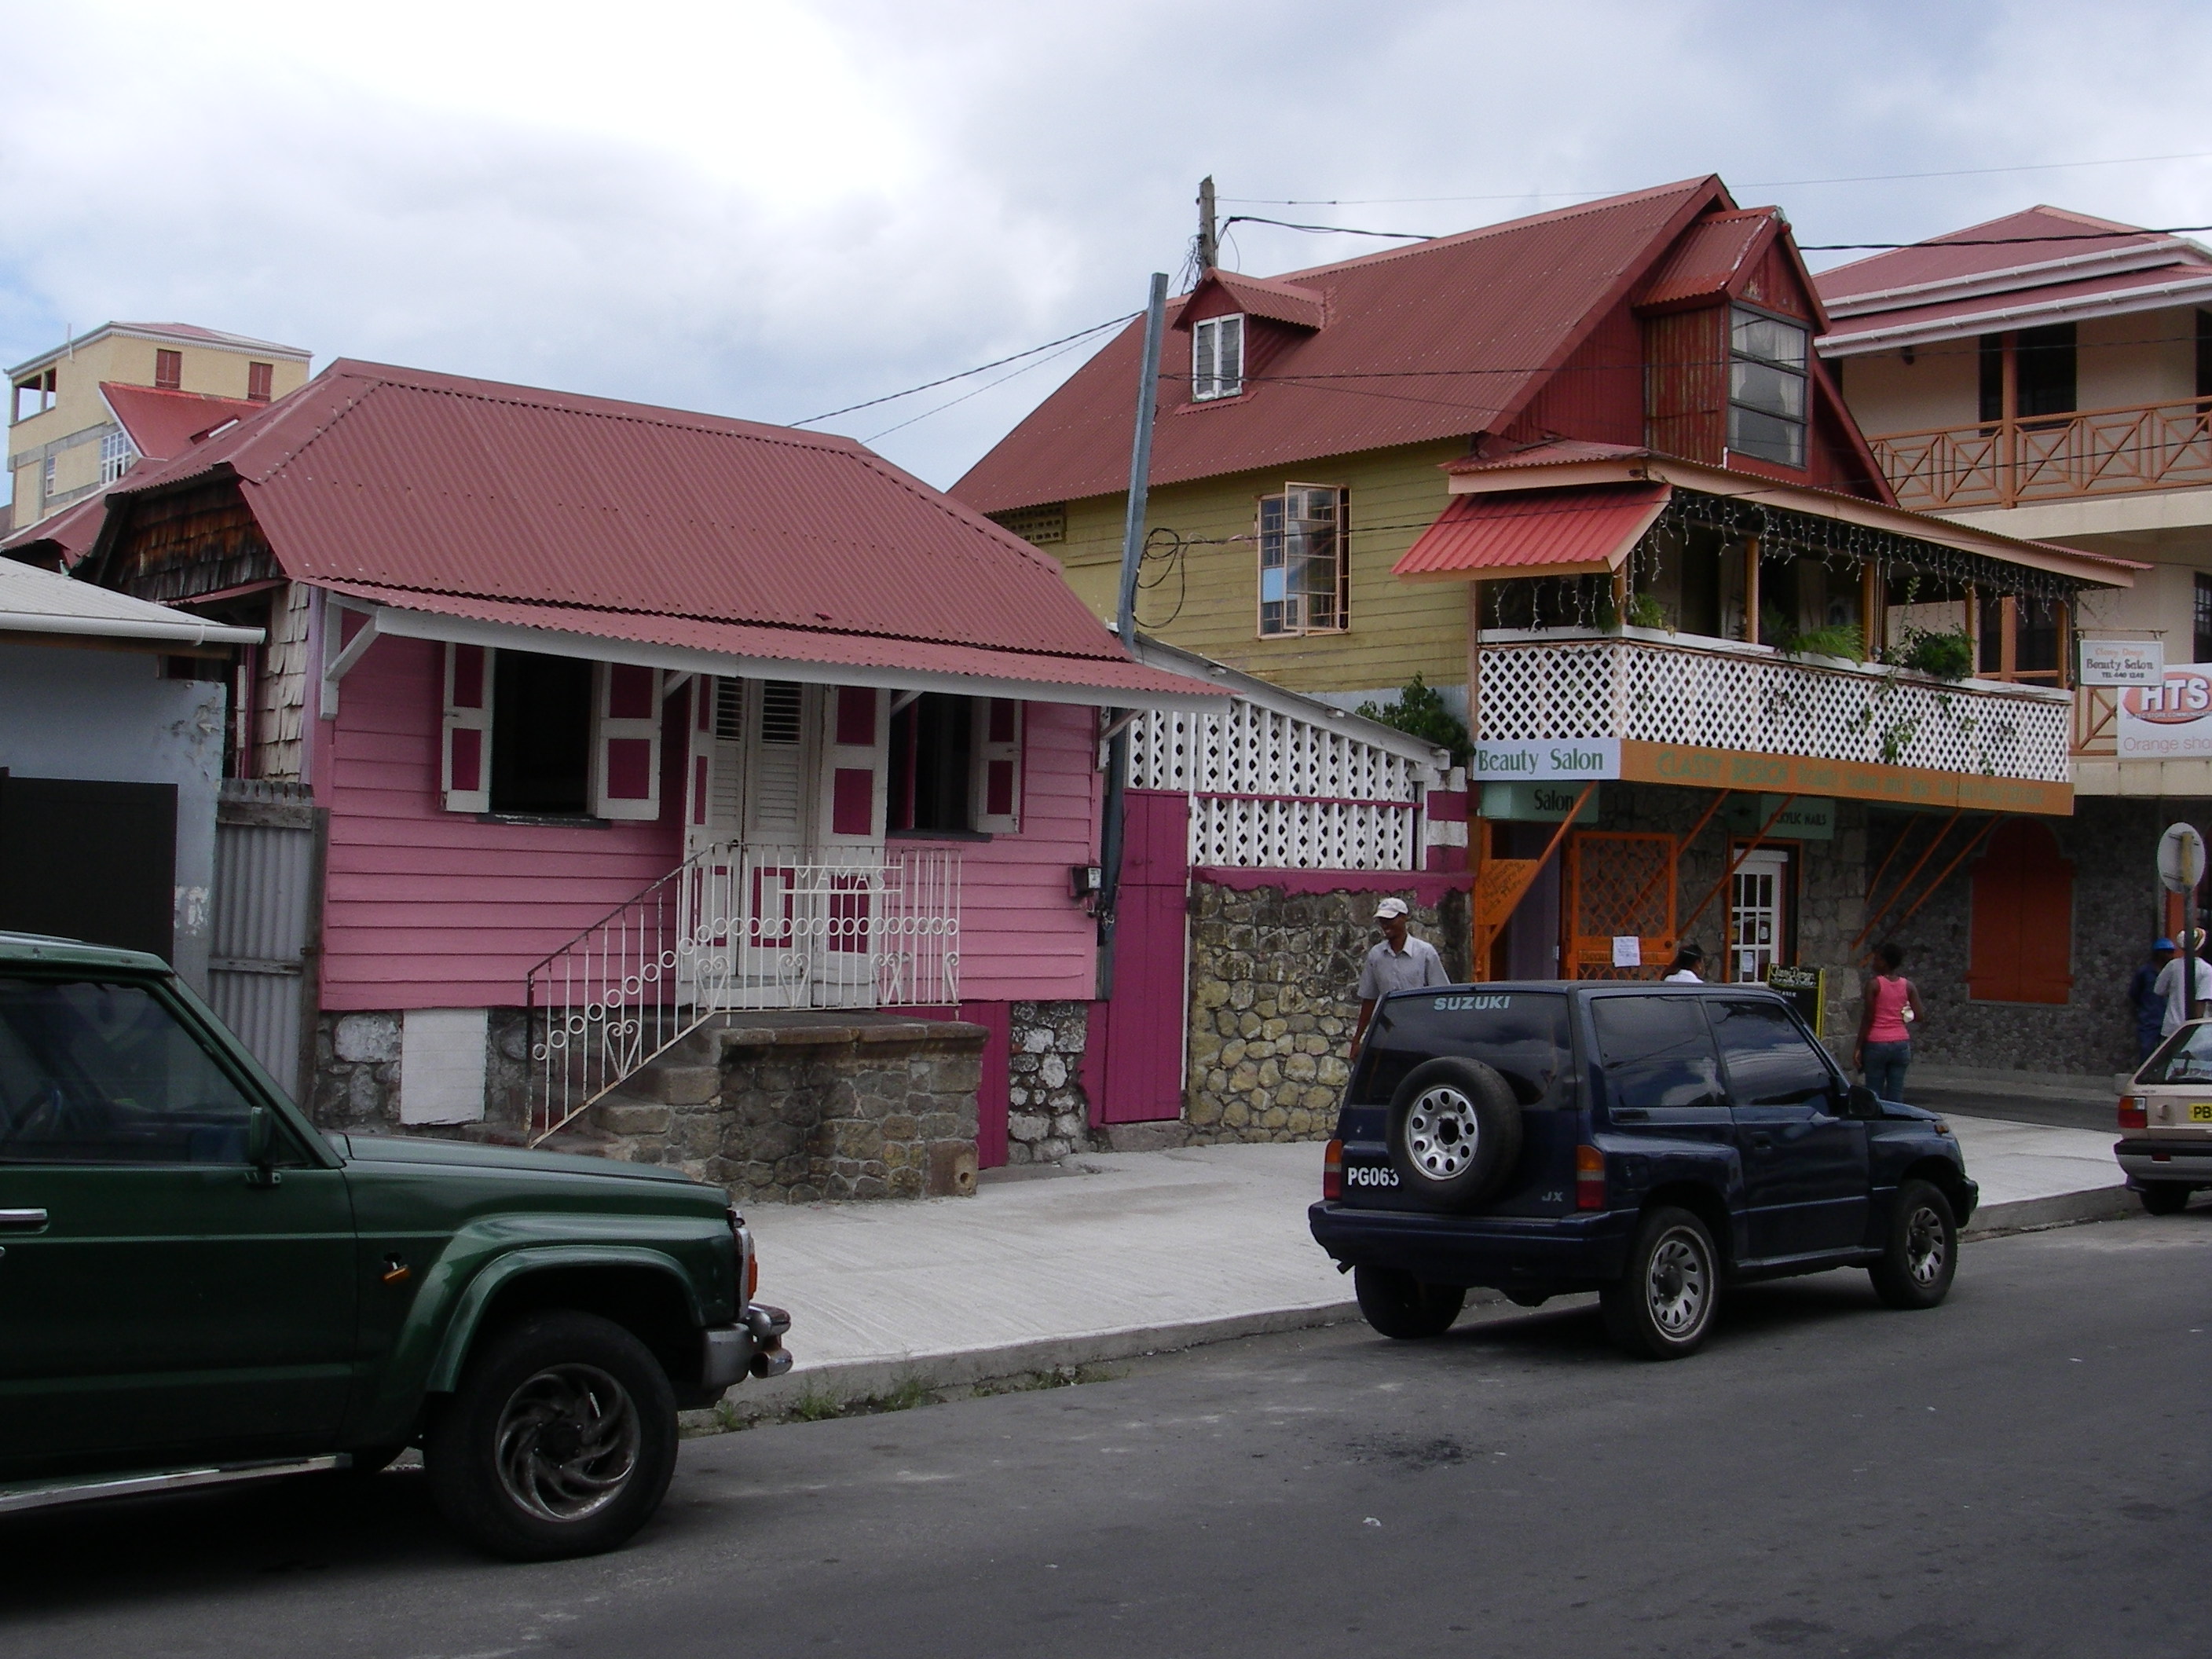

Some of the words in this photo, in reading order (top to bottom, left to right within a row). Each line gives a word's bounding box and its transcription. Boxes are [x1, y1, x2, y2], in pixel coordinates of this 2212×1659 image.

[2086, 658, 2121, 671] Beauty
[2125, 658, 2154, 669] Salon
[2141, 677, 2210, 711] HTS
[2123, 737, 2179, 753] Orange
[2183, 736, 2212, 749] sho
[1478, 749, 1539, 775] Beauty
[1550, 748, 1603, 771] Salon
[1655, 751, 1721, 779] CLASSY
[1533, 789, 1574, 811] Salon
[1771, 812, 1801, 824] RYLIC
[793, 868, 886, 891] MAMAS
[1434, 995, 1511, 1011] SUZUKI
[2194, 1106, 2212, 1119] PB
[1348, 1167, 1399, 1186] PG063
[1542, 1191, 1564, 1202] JX
